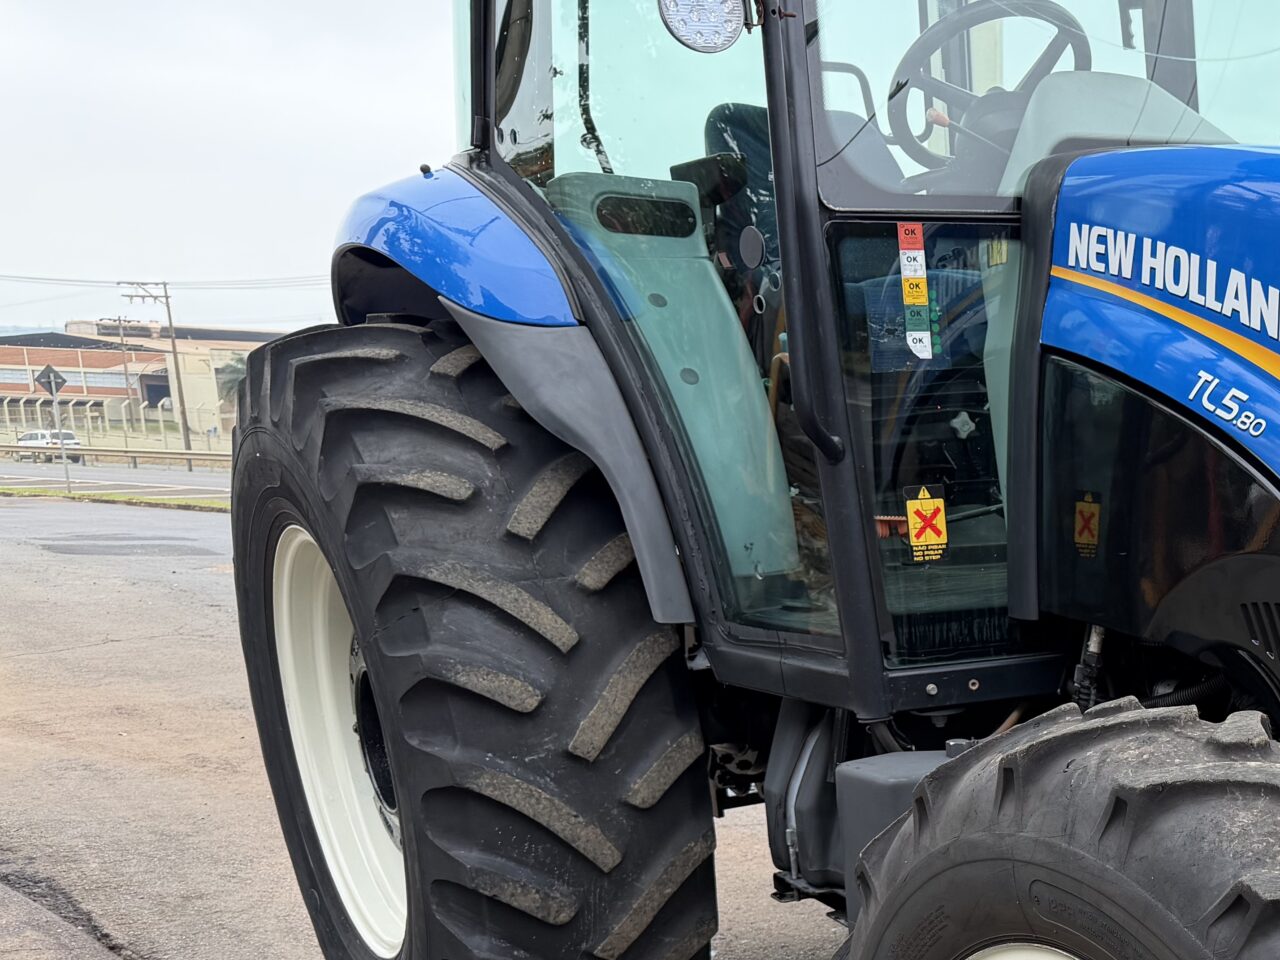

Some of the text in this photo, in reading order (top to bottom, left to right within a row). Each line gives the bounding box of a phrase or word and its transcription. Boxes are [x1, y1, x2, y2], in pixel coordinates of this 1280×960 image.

[904, 228, 916, 236] OK
[1068, 222, 1136, 279] NEW
[909, 282, 921, 290] OK
[912, 337, 924, 345] OK
[1188, 370, 1267, 436] TL5.80
